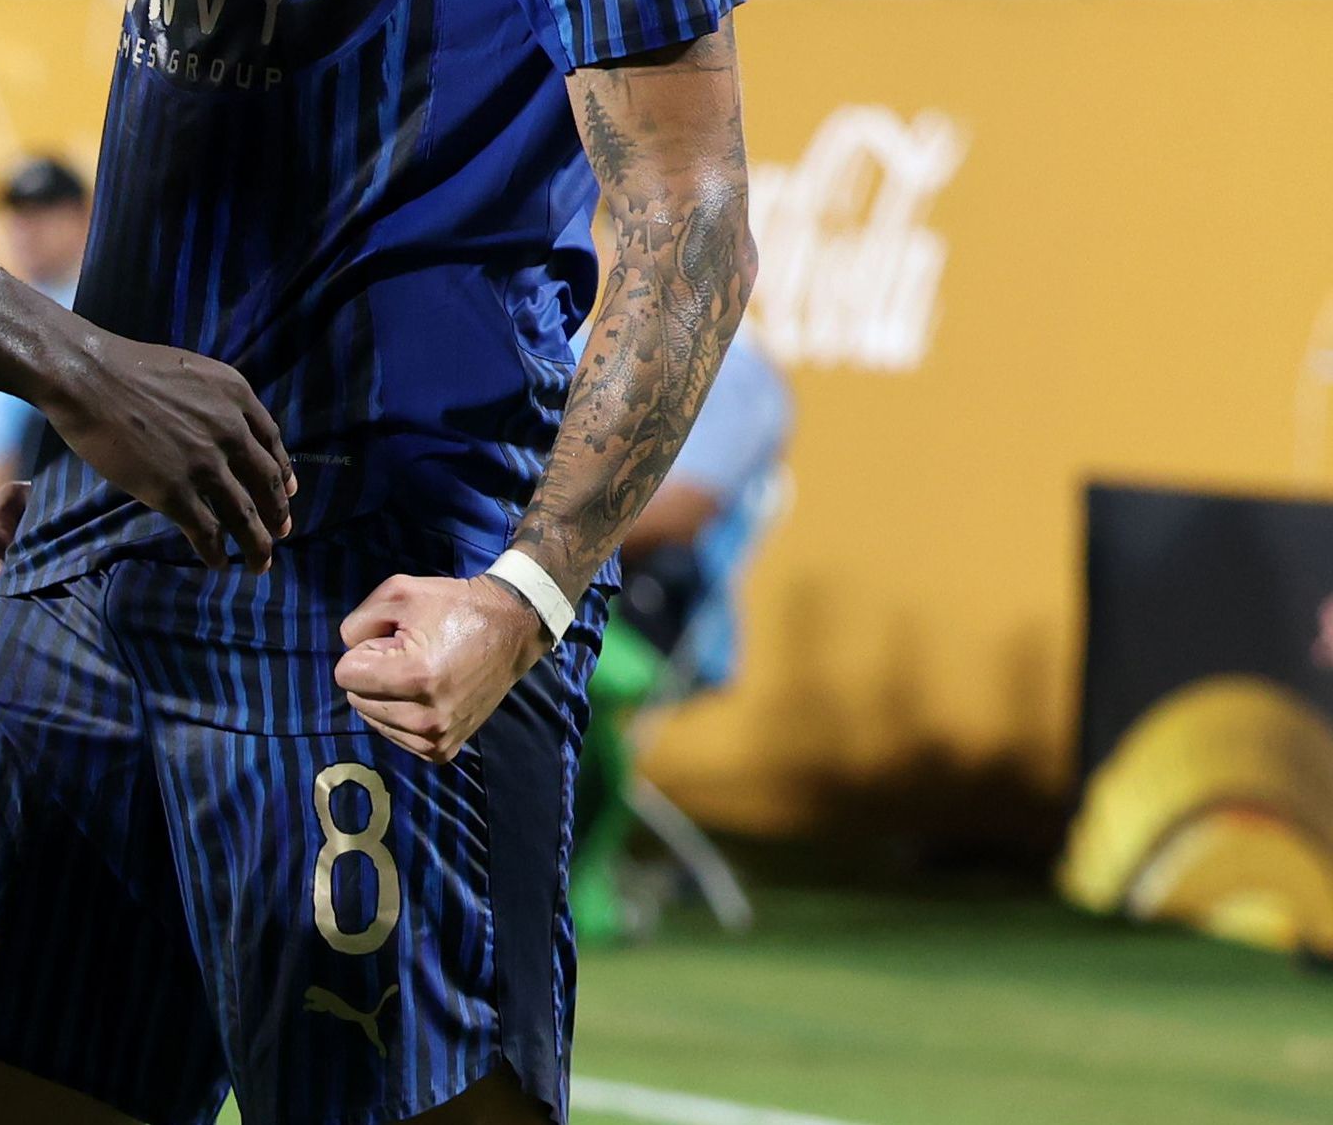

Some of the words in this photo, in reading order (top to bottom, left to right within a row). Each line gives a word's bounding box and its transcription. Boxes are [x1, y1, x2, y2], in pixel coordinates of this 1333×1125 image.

[117, 35, 158, 68] MES
[166, 49, 283, 92] GROUP
[313, 762, 401, 954] 8
